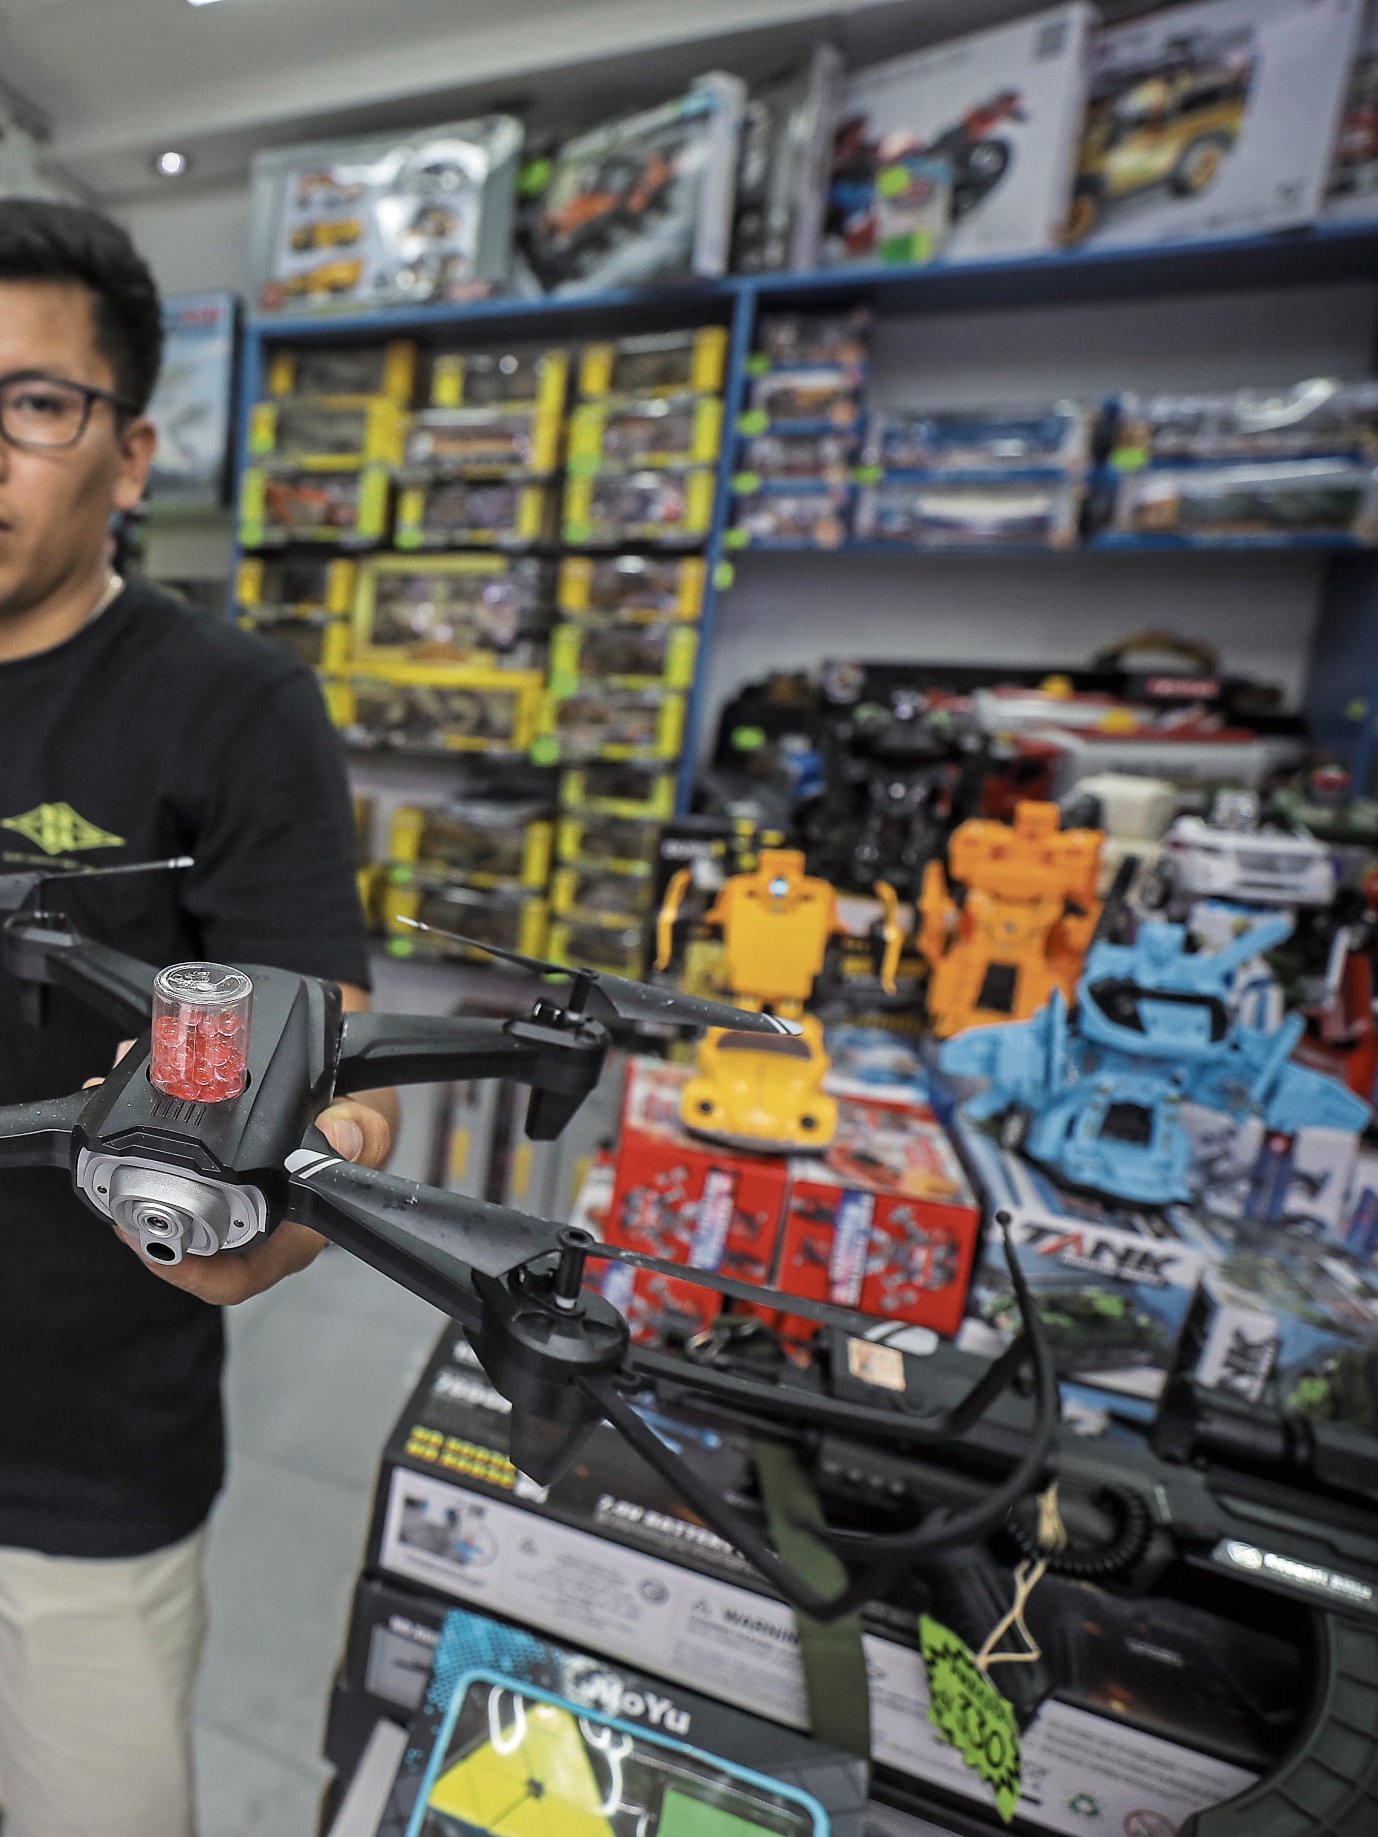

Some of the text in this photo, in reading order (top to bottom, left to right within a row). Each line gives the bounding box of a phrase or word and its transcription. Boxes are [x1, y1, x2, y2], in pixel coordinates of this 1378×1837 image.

[1023, 1223, 1177, 1279] TANK
[723, 1608, 801, 1647] WARNIN
[579, 1672, 692, 1736] MoYu
